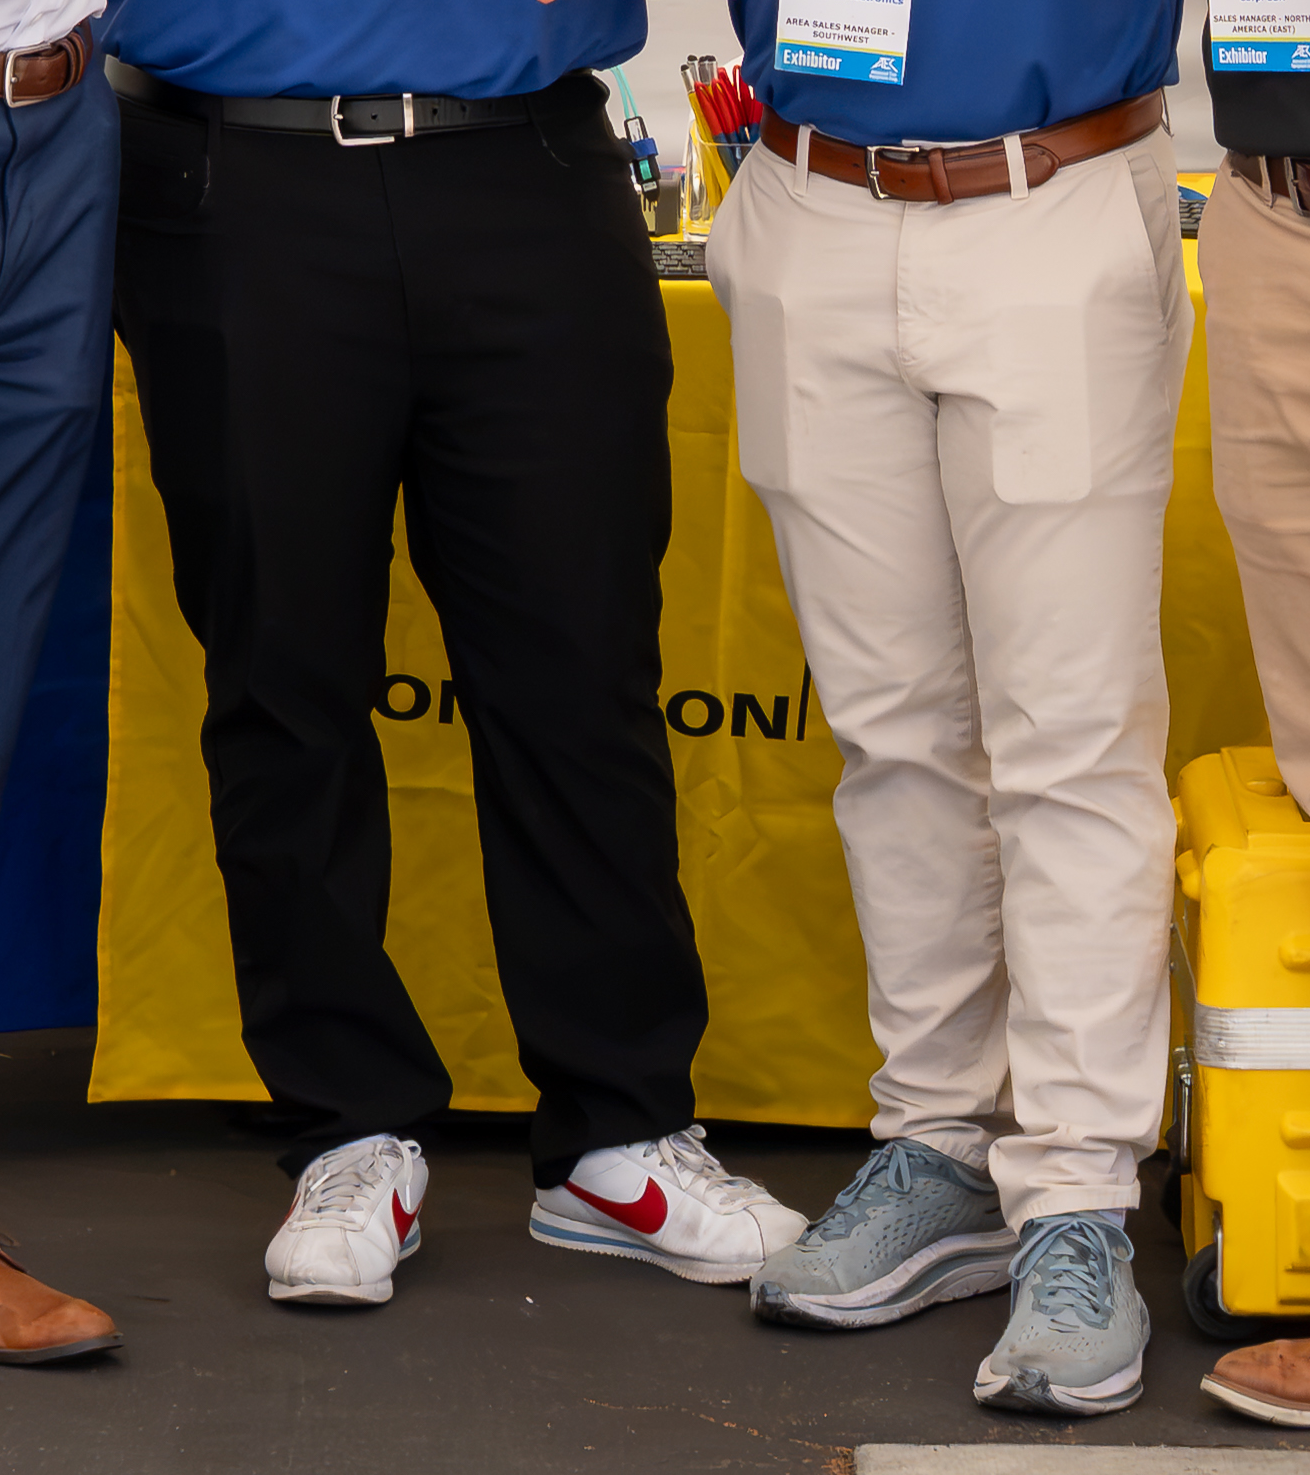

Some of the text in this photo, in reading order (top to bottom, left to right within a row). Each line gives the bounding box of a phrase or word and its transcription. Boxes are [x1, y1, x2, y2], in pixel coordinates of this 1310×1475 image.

[786, 18, 888, 36] AREA SALES MANAGER
[1269, 26, 1296, 34] (EAST)
[813, 31, 869, 43] SOUTHWEST
[783, 49, 842, 70] Exhibitor
[1219, 47, 1267, 64] Exhibitor
